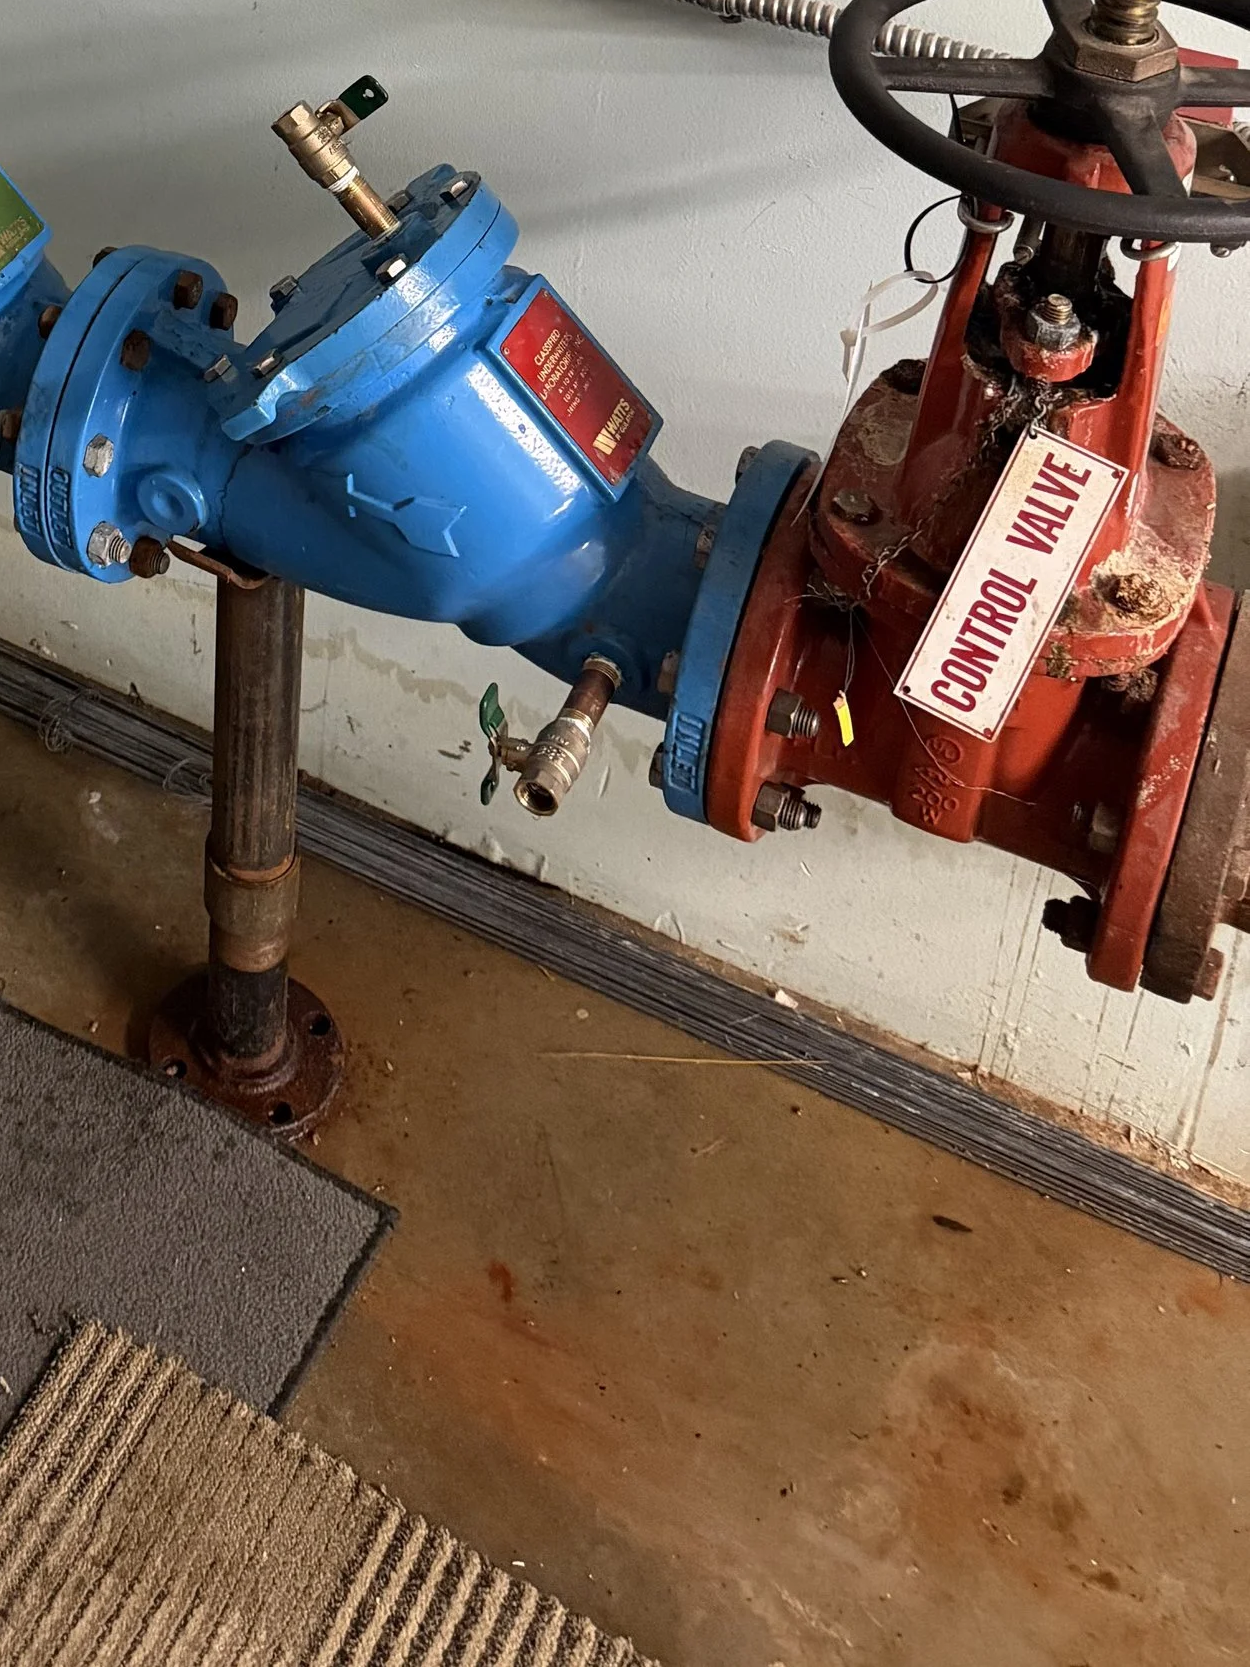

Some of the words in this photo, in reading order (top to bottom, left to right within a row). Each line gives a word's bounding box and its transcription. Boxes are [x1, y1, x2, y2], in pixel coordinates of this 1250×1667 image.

[533, 328, 561, 366] CLASSIFIED
[536, 331, 574, 383] UNDERWRITERS
[605, 397, 631, 434] WATTS
[1005, 452, 1092, 555] VALVE
[930, 568, 1038, 713] CONTROL
[671, 713, 703, 790] INLET
